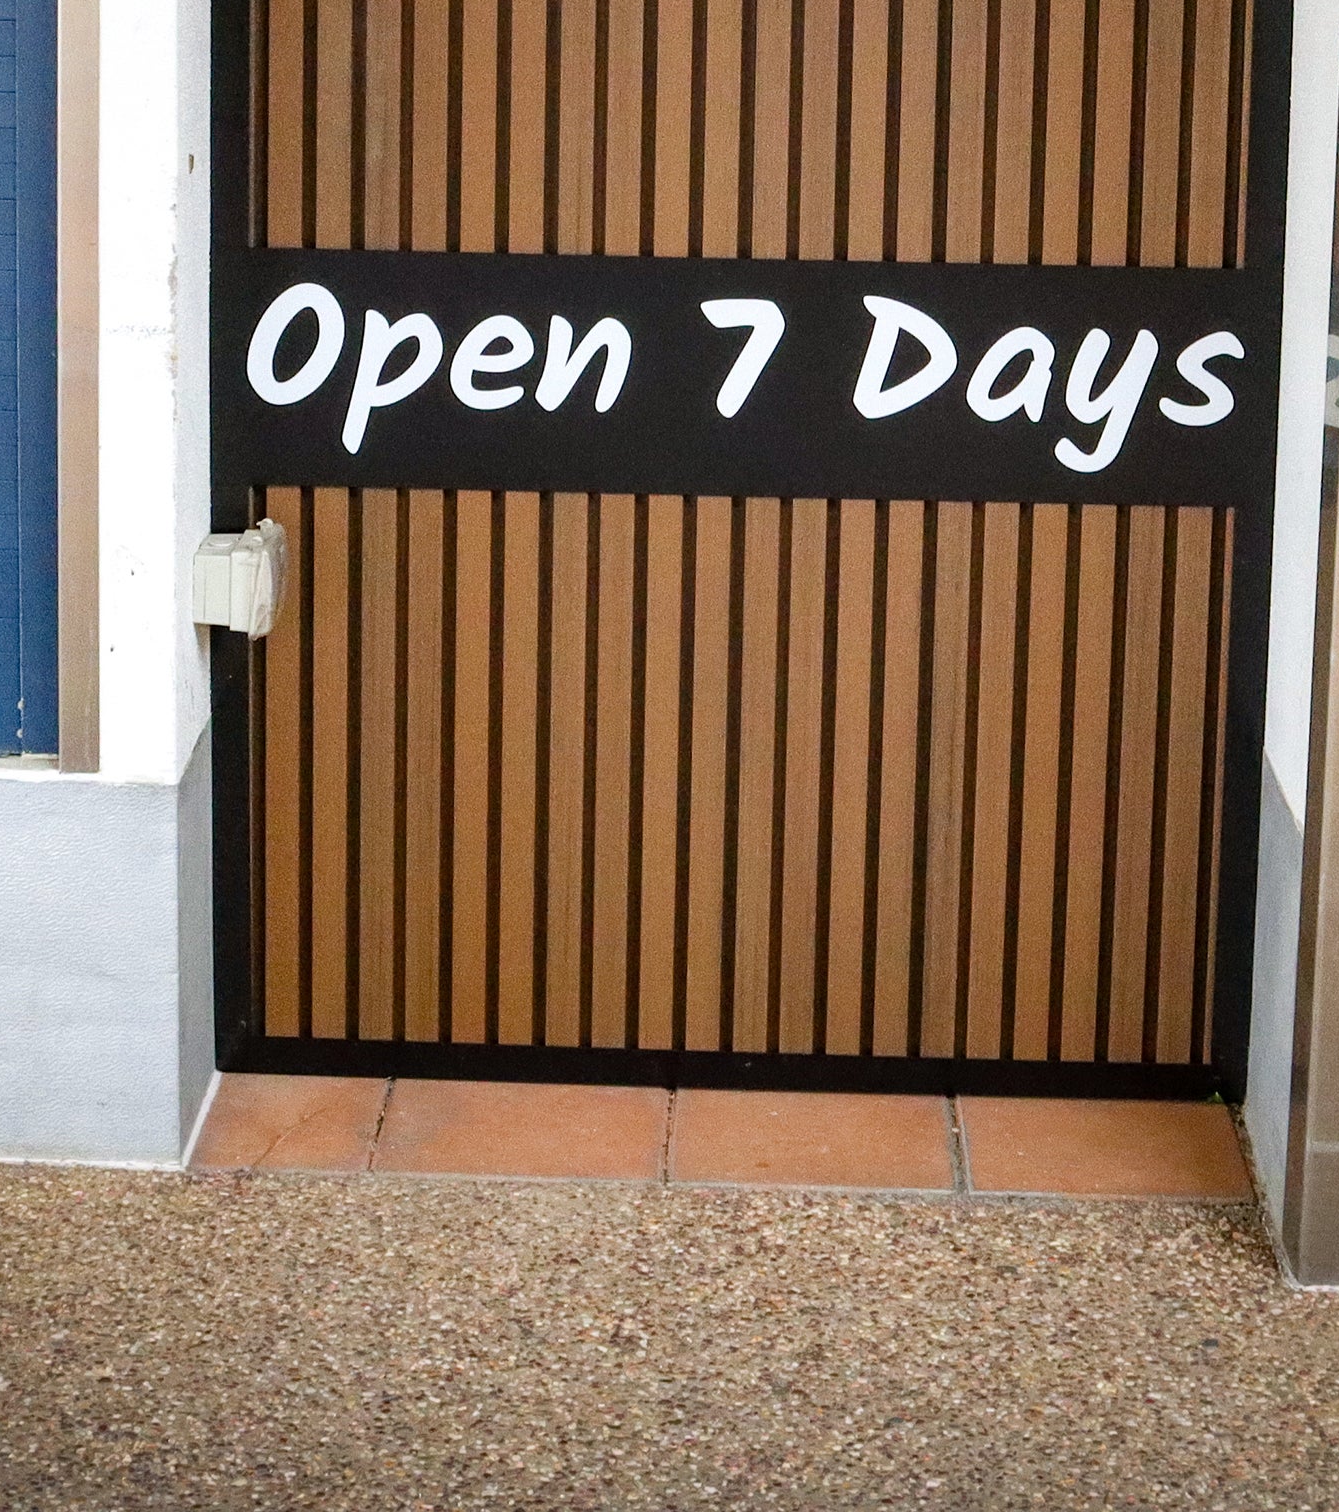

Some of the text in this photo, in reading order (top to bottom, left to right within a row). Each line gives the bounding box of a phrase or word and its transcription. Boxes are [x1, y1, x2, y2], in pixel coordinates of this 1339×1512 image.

[246, 282, 1245, 474] Open 7 Days
